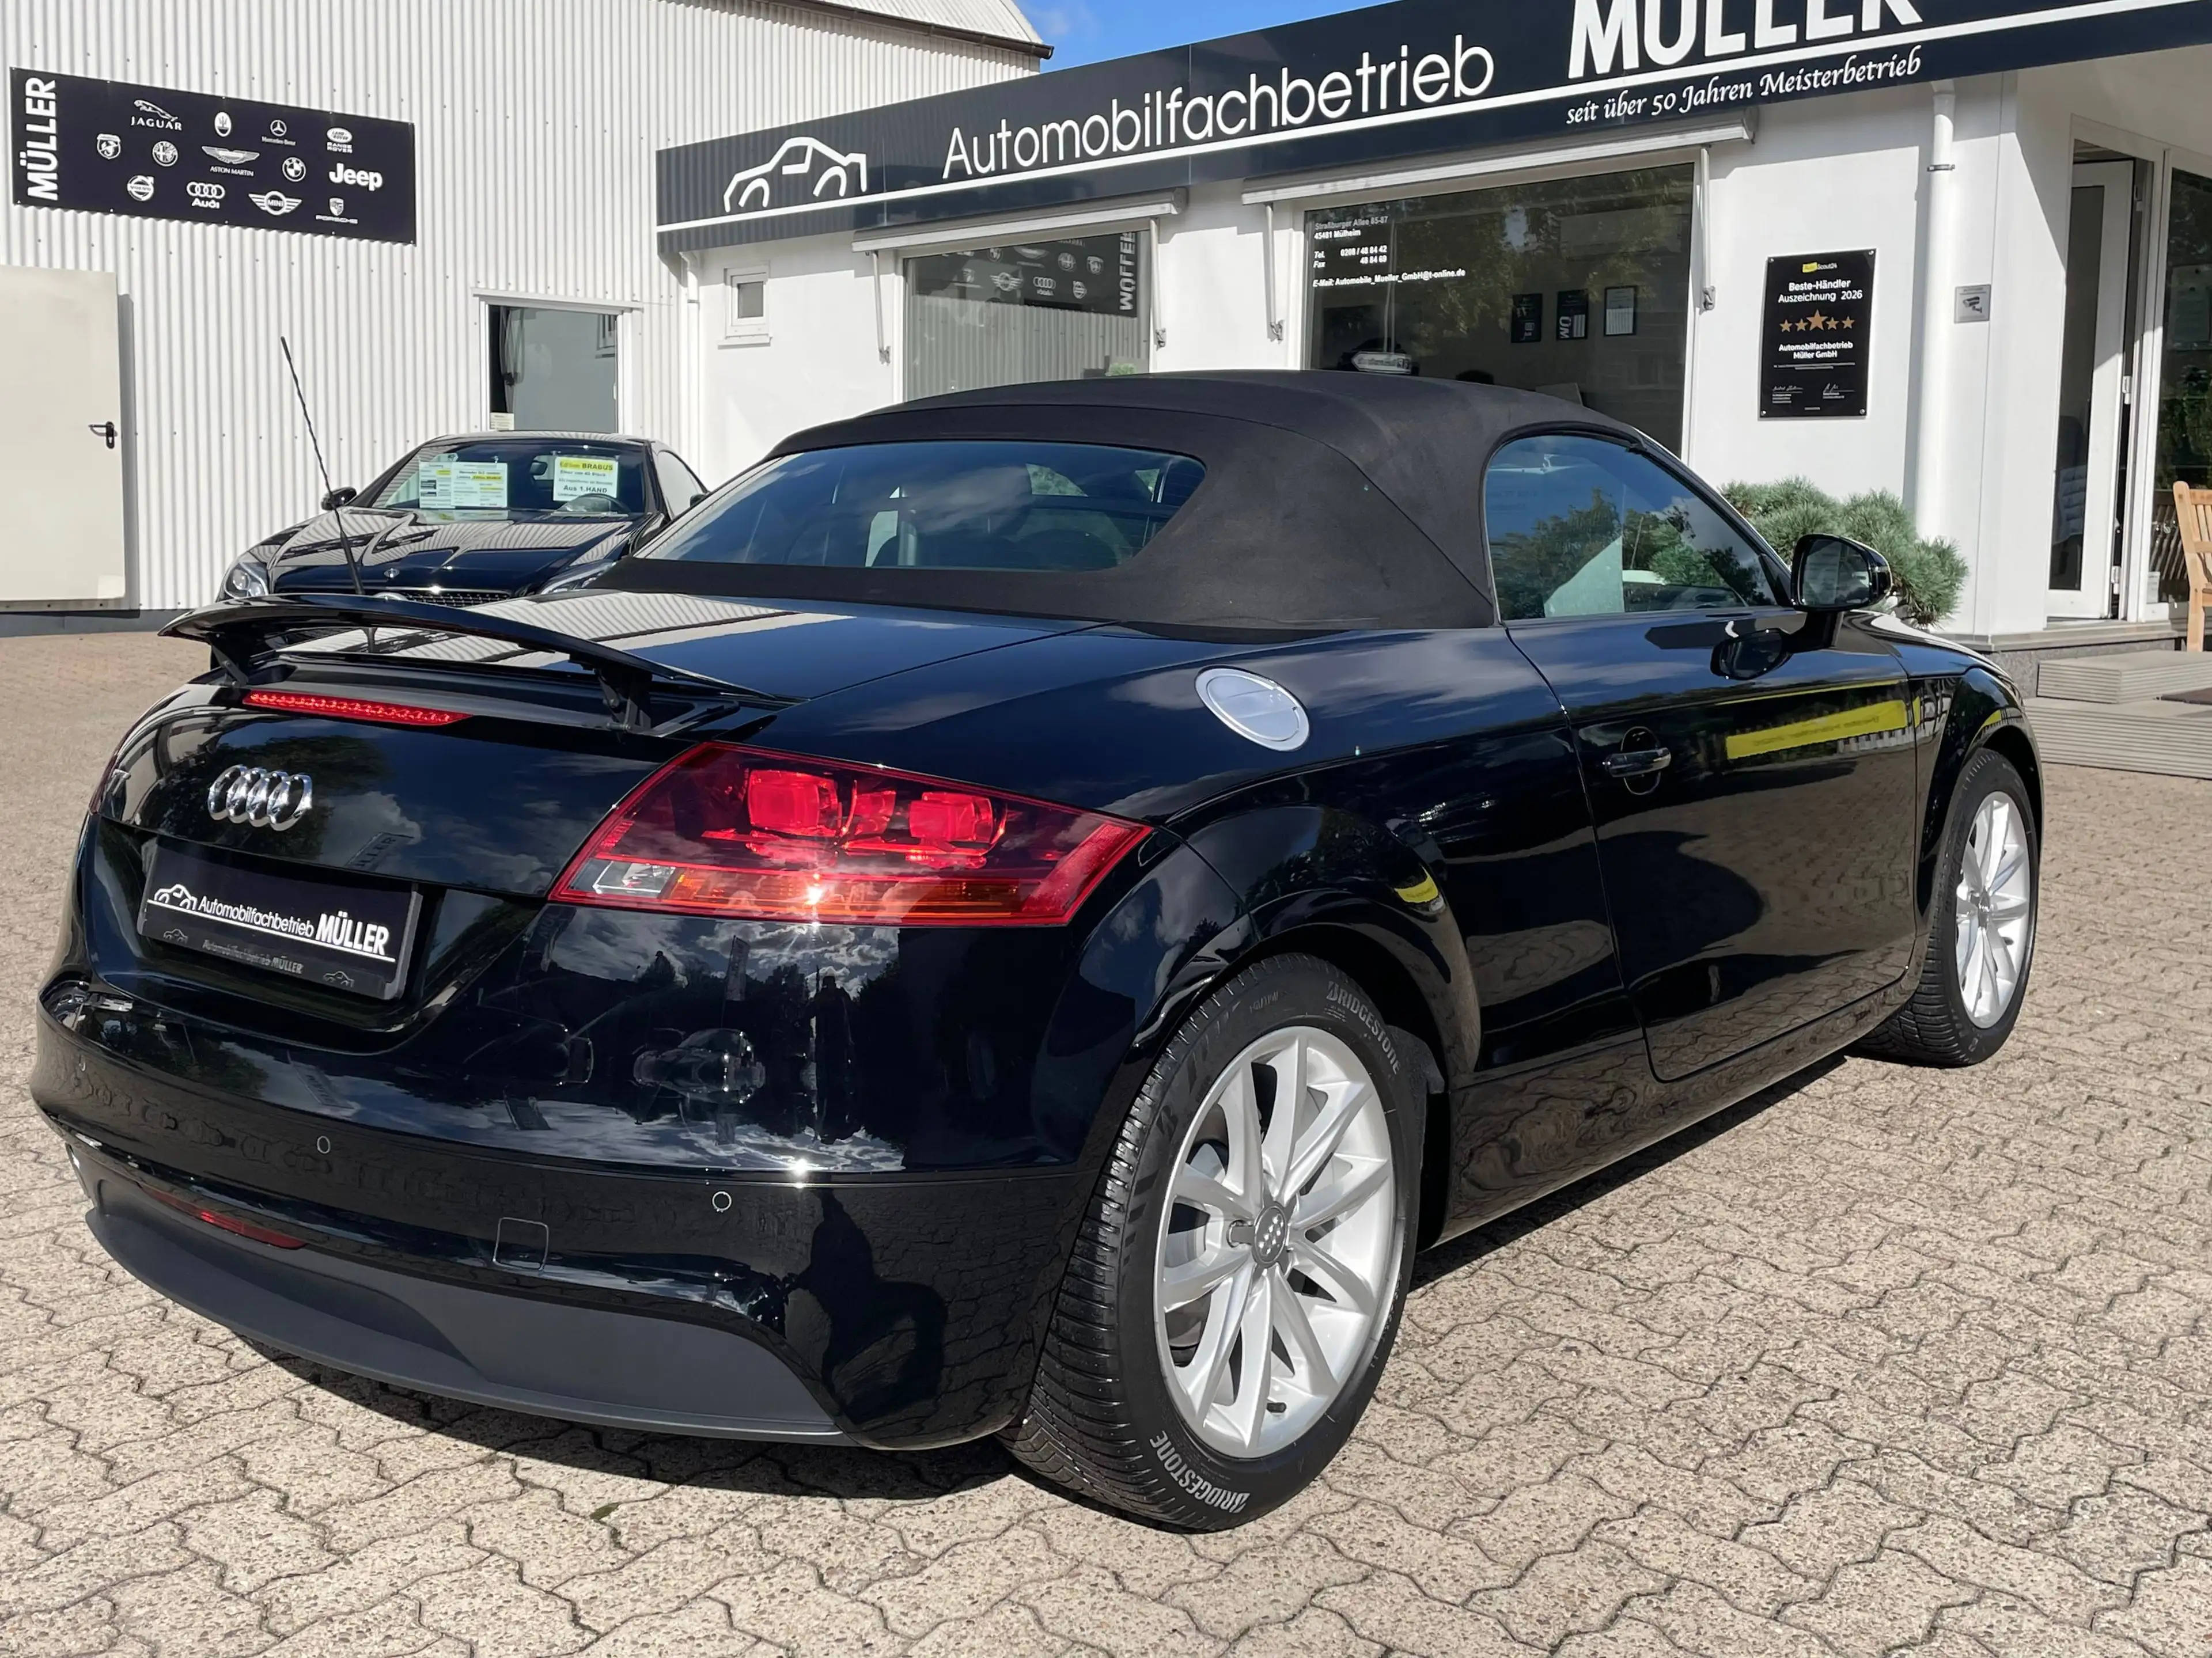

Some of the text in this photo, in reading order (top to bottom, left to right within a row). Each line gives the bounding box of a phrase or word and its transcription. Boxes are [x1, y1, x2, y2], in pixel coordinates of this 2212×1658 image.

[1566, 45, 1923, 124] seit über 50 Jahren Meisterbetrieb
[942, 35, 1494, 179] Automobilfachbetrieb
[131, 116, 183, 131] JAGUAR
[19, 77, 58, 201] MÜLLER
[231, 169, 253, 177] MARTIN
[329, 163, 382, 191] Jeep
[191, 198, 220, 208] Audi
[267, 199, 283, 207] MINI
[1789, 279, 1851, 291] Beste-Händler
[1778, 289, 1863, 303] Auszeichnung 2026
[1778, 340, 1854, 351] Automobilfachbetrieb
[1793, 350, 1838, 359] Müller GmbH
[198, 896, 389, 956] Automobilfachbetrieb MÜLLER
[1325, 980, 1401, 1075] BRIDGESTONE
[1149, 1430, 1251, 1513] BRIDGESTONE
